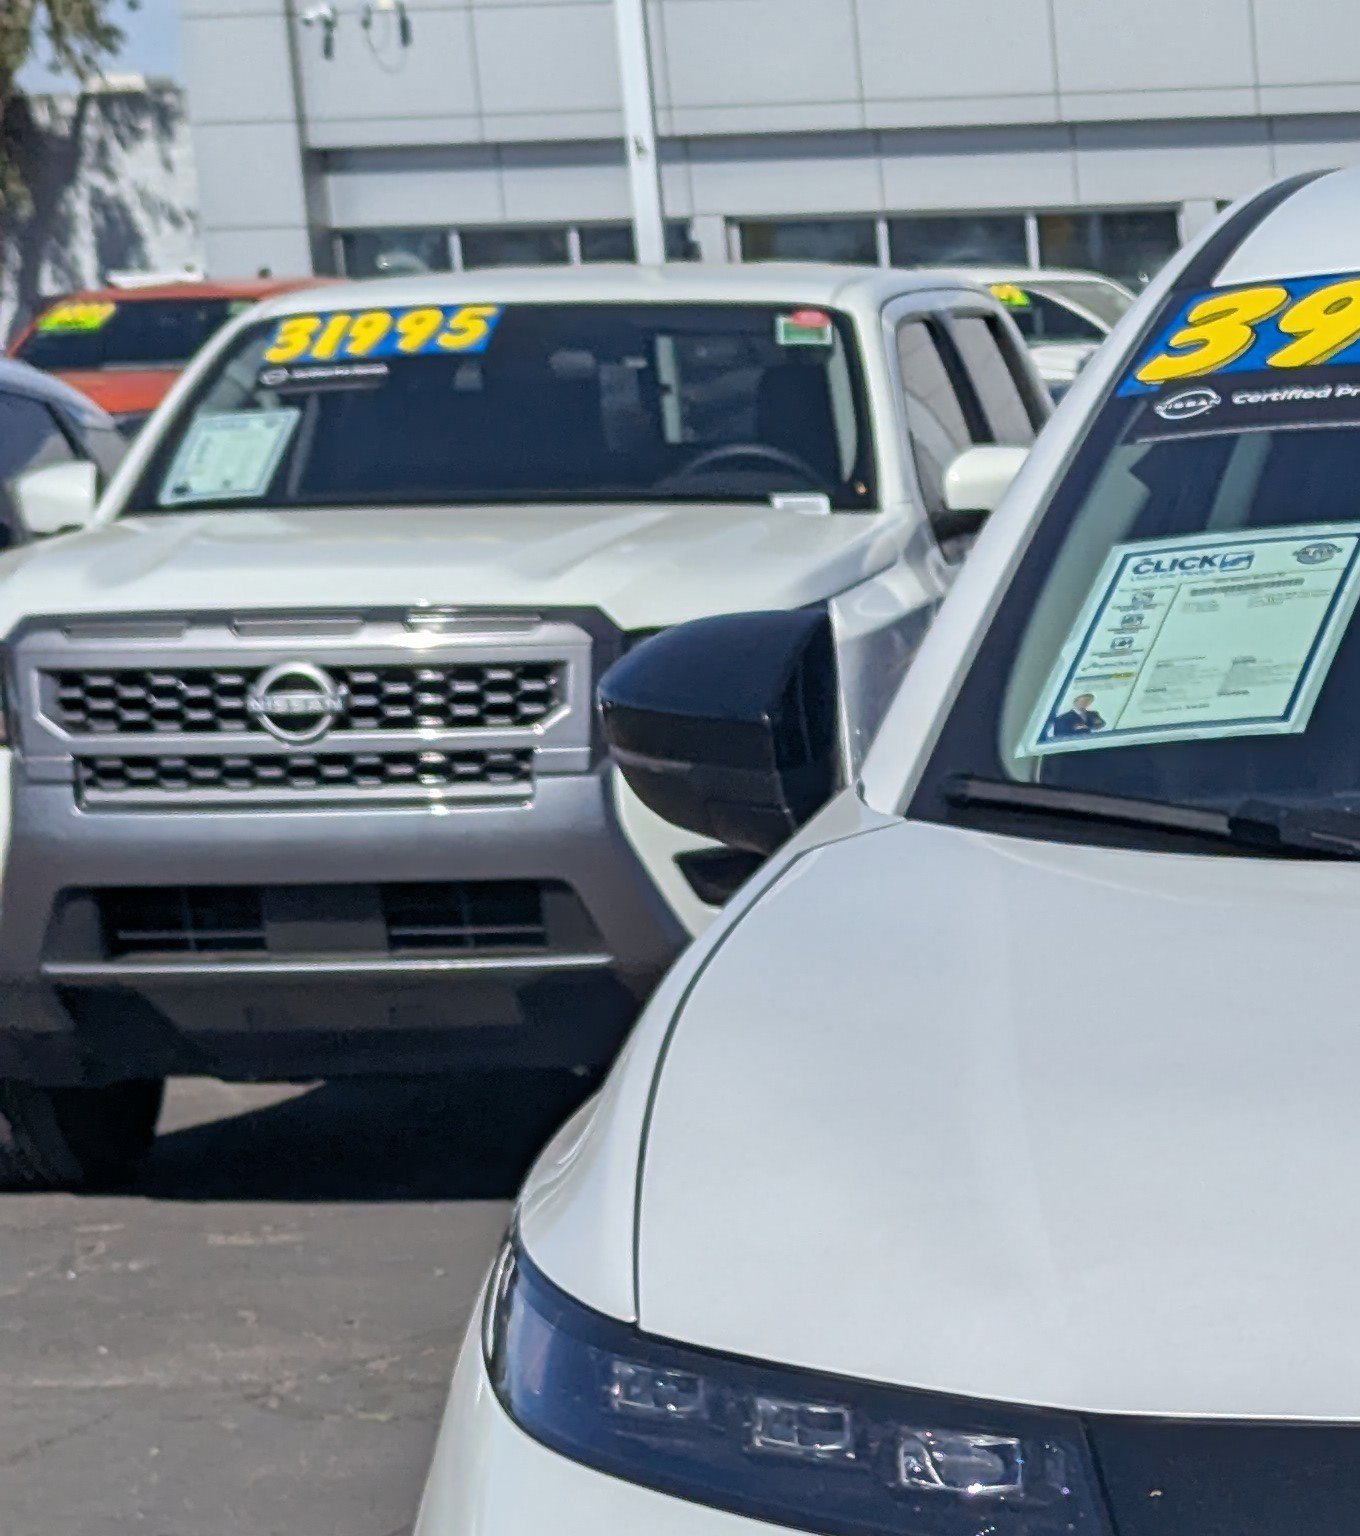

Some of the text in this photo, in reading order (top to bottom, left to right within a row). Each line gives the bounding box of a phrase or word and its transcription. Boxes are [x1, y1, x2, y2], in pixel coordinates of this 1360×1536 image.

[264, 304, 498, 363] 31995
[1231, 385, 1333, 405] Certified
[1132, 553, 1221, 576] CLICK
